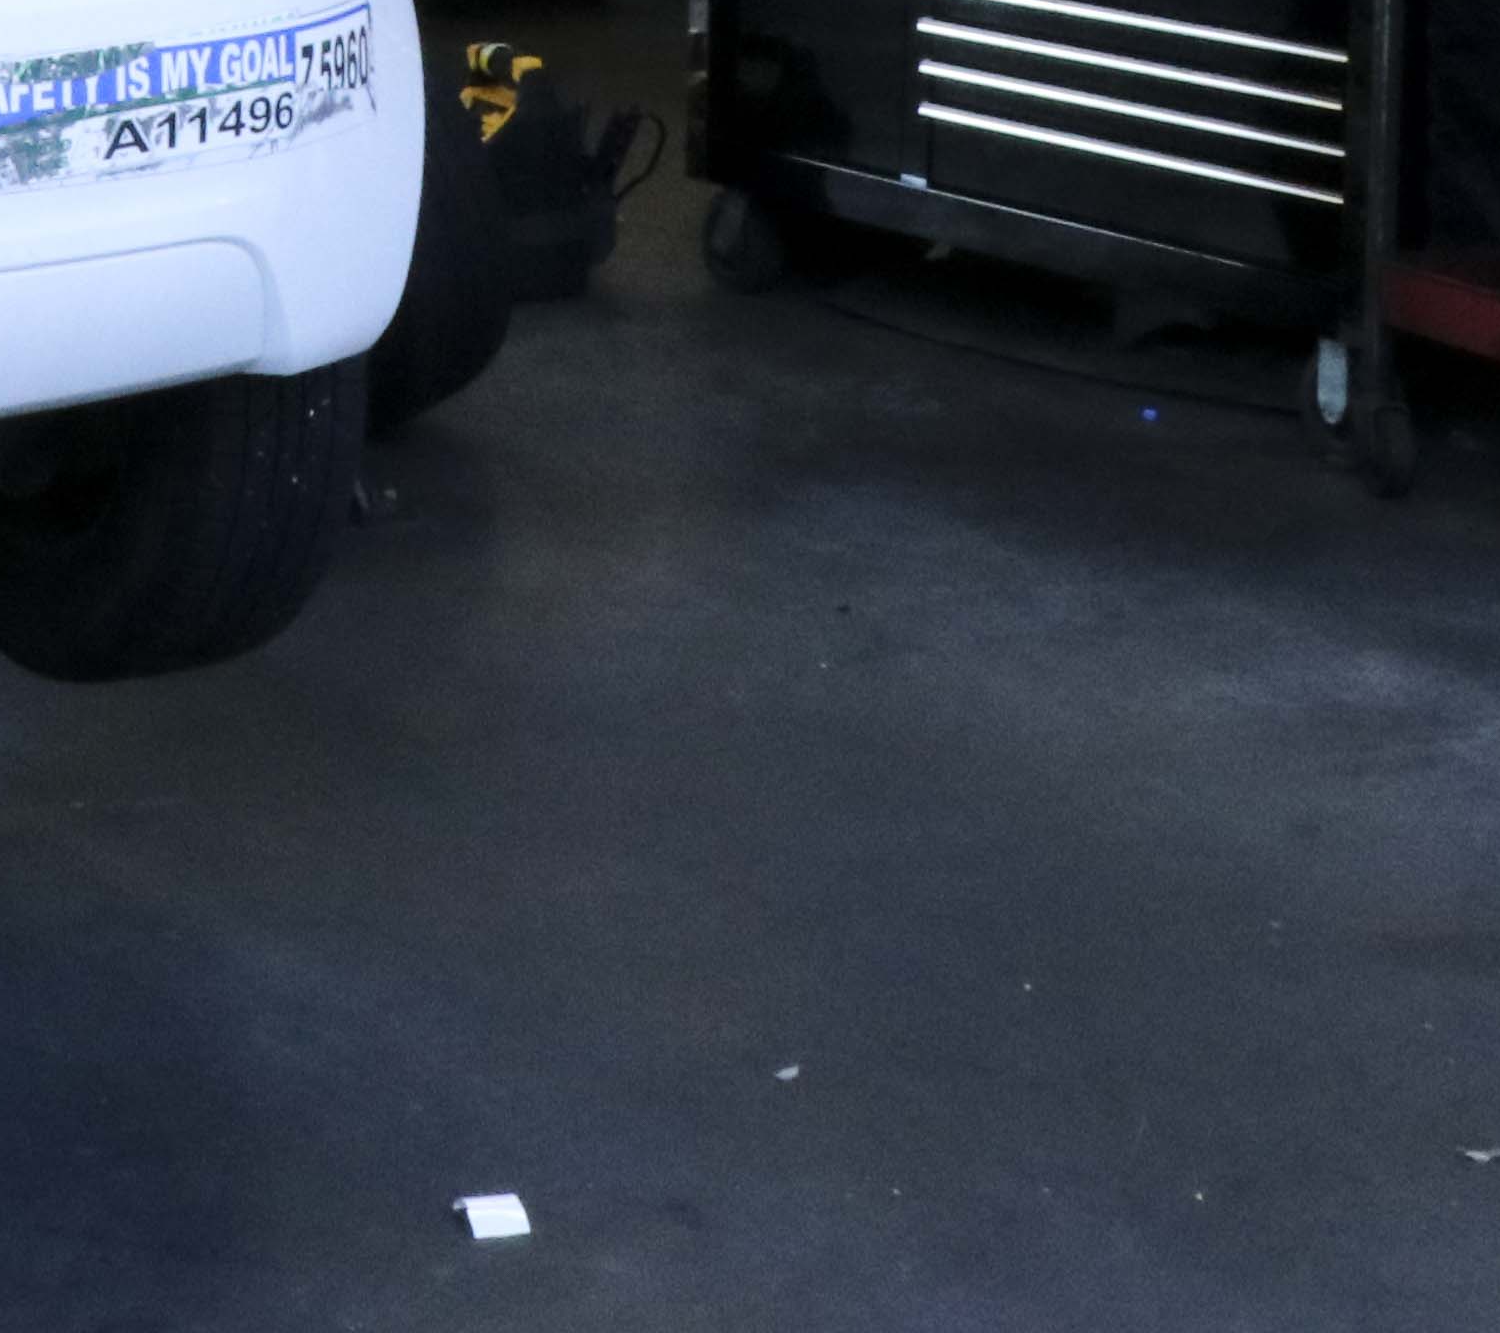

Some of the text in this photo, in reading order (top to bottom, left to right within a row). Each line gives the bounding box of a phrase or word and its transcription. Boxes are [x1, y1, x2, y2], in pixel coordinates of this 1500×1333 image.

[114, 51, 153, 103] IS
[159, 39, 214, 96] MY
[218, 32, 296, 86] GOAL
[104, 91, 295, 161] A11496
